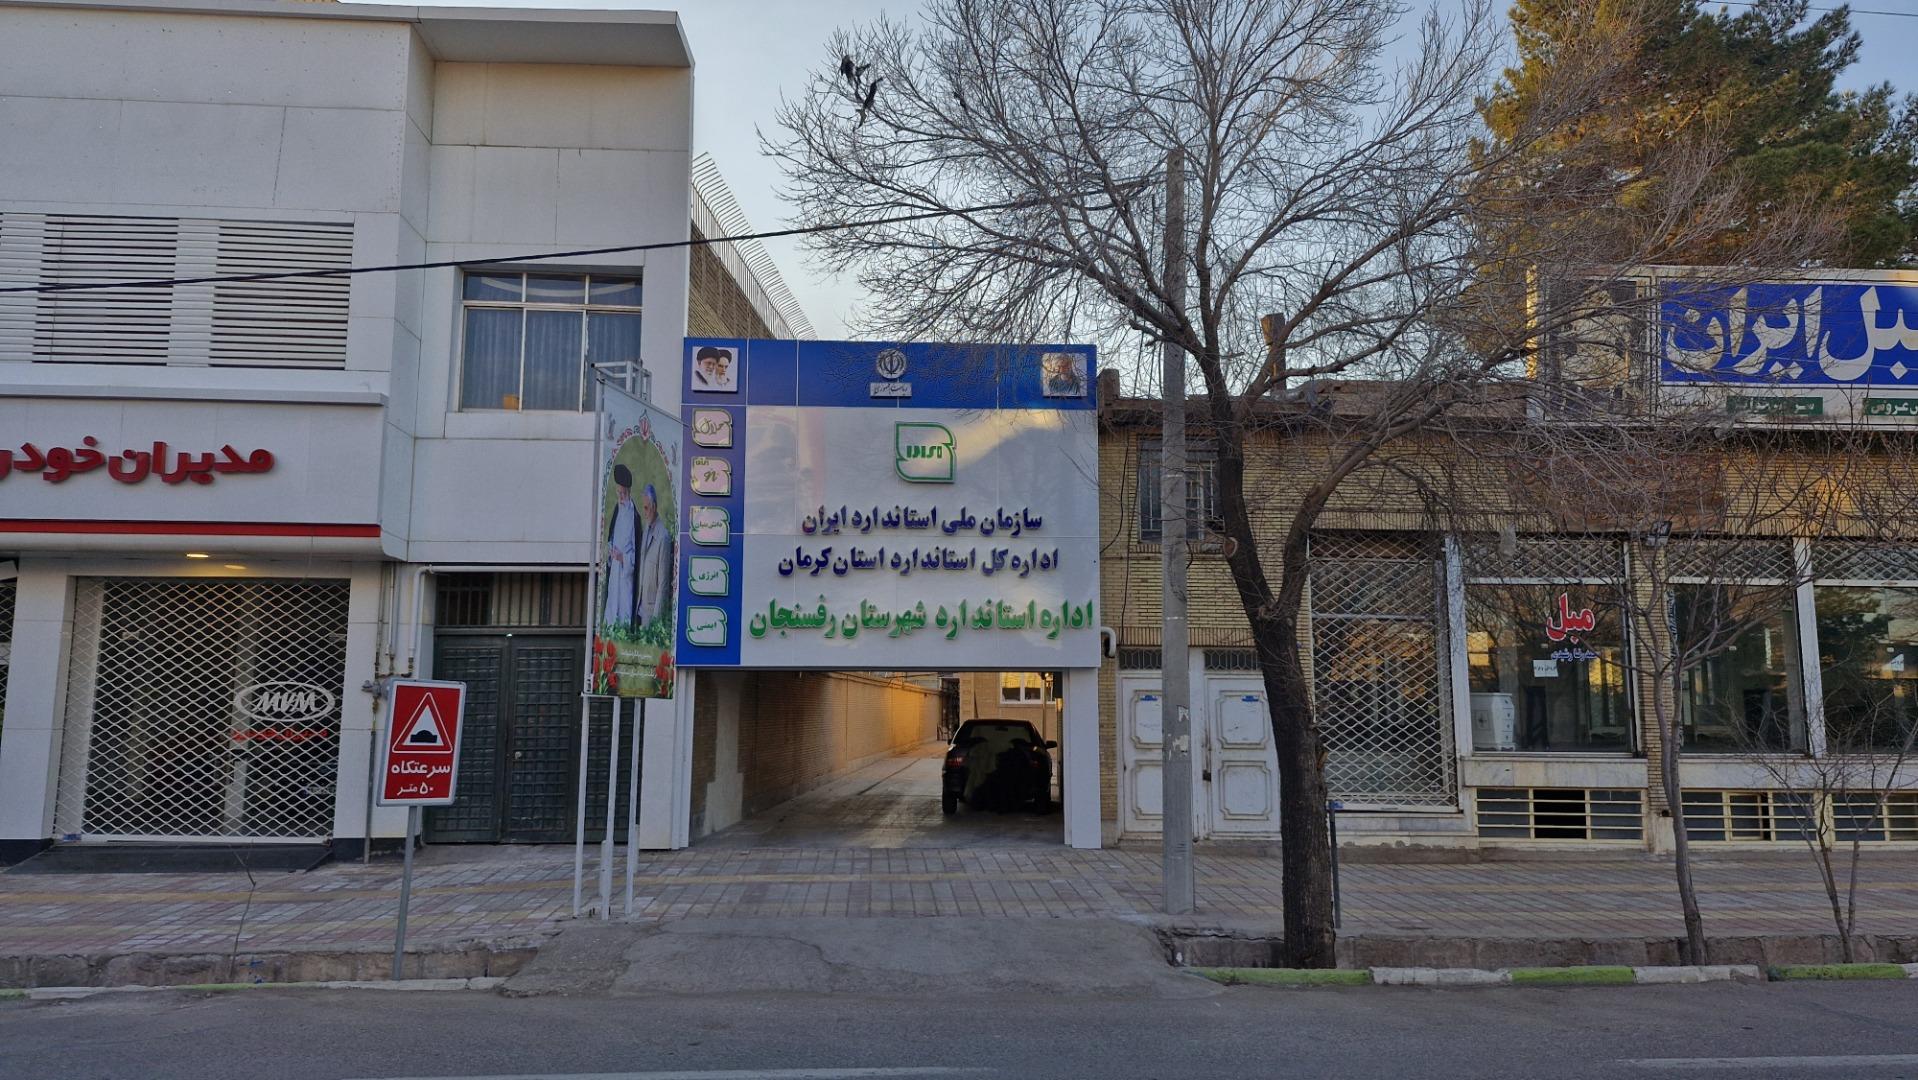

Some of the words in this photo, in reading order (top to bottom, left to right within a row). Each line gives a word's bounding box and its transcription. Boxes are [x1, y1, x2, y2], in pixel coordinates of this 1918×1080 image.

[1666, 286, 1824, 380] ایران
[1819, 286, 1918, 381] بل
[108, 441, 274, 484] مدیران
[801, 505, 848, 536] ایران
[851, 505, 938, 535] استاندارد
[941, 506, 977, 538] ملی
[980, 506, 1043, 538] سازمان
[778, 546, 833, 579] کرمان
[832, 547, 885, 577] استان
[890, 546, 977, 577] استاندارد
[981, 548, 1009, 577] کل
[1011, 548, 1060, 579] اداره
[749, 594, 837, 639] رفسنجان
[841, 599, 927, 639] شهرستان
[935, 598, 1037, 640] استاندارد
[1041, 600, 1094, 640] اداره
[1545, 592, 1596, 645] مبل
[251, 692, 320, 714] MVM
[396, 783, 419, 797] متر
[419, 781, 435, 795] ۵۰
